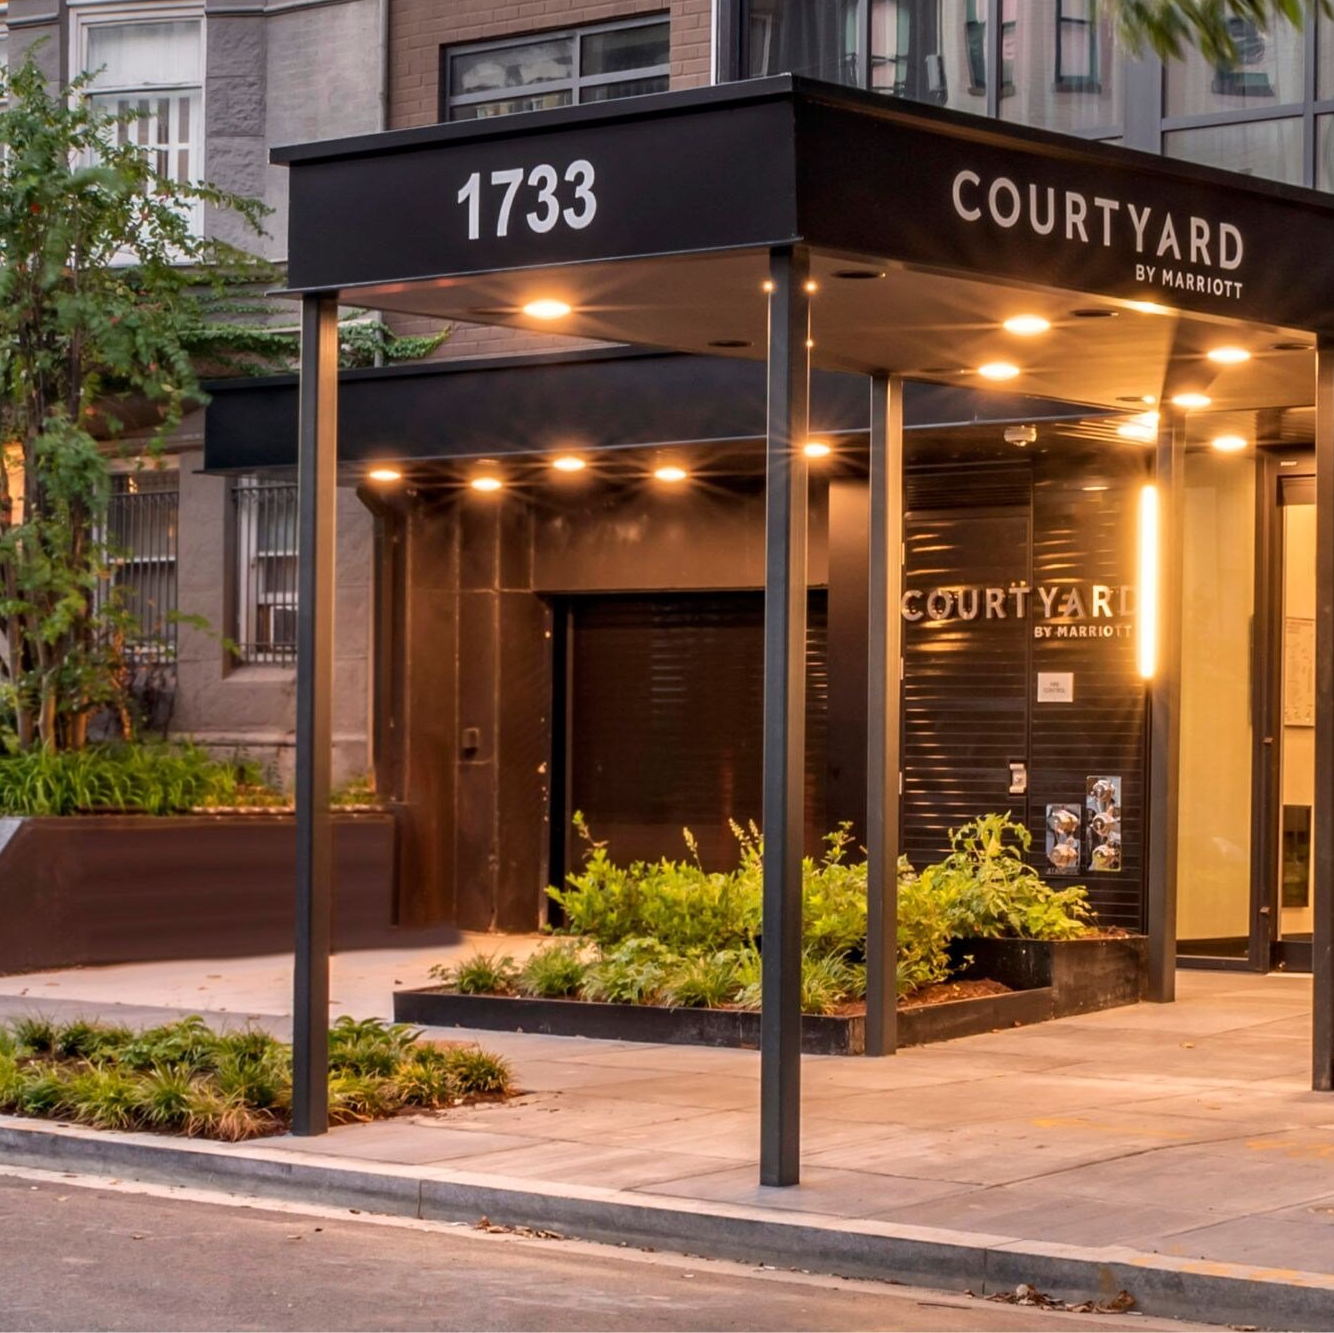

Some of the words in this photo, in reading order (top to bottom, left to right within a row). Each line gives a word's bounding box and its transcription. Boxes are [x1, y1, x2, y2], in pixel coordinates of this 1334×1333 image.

[457, 159, 597, 240] 1733
[952, 170, 1244, 271] COURTYARD
[1135, 264, 1156, 282] BY
[1162, 269, 1243, 299] MARRIOTT
[1034, 626, 1052, 638] BY
[1056, 625, 1132, 638] MARRIOTT
